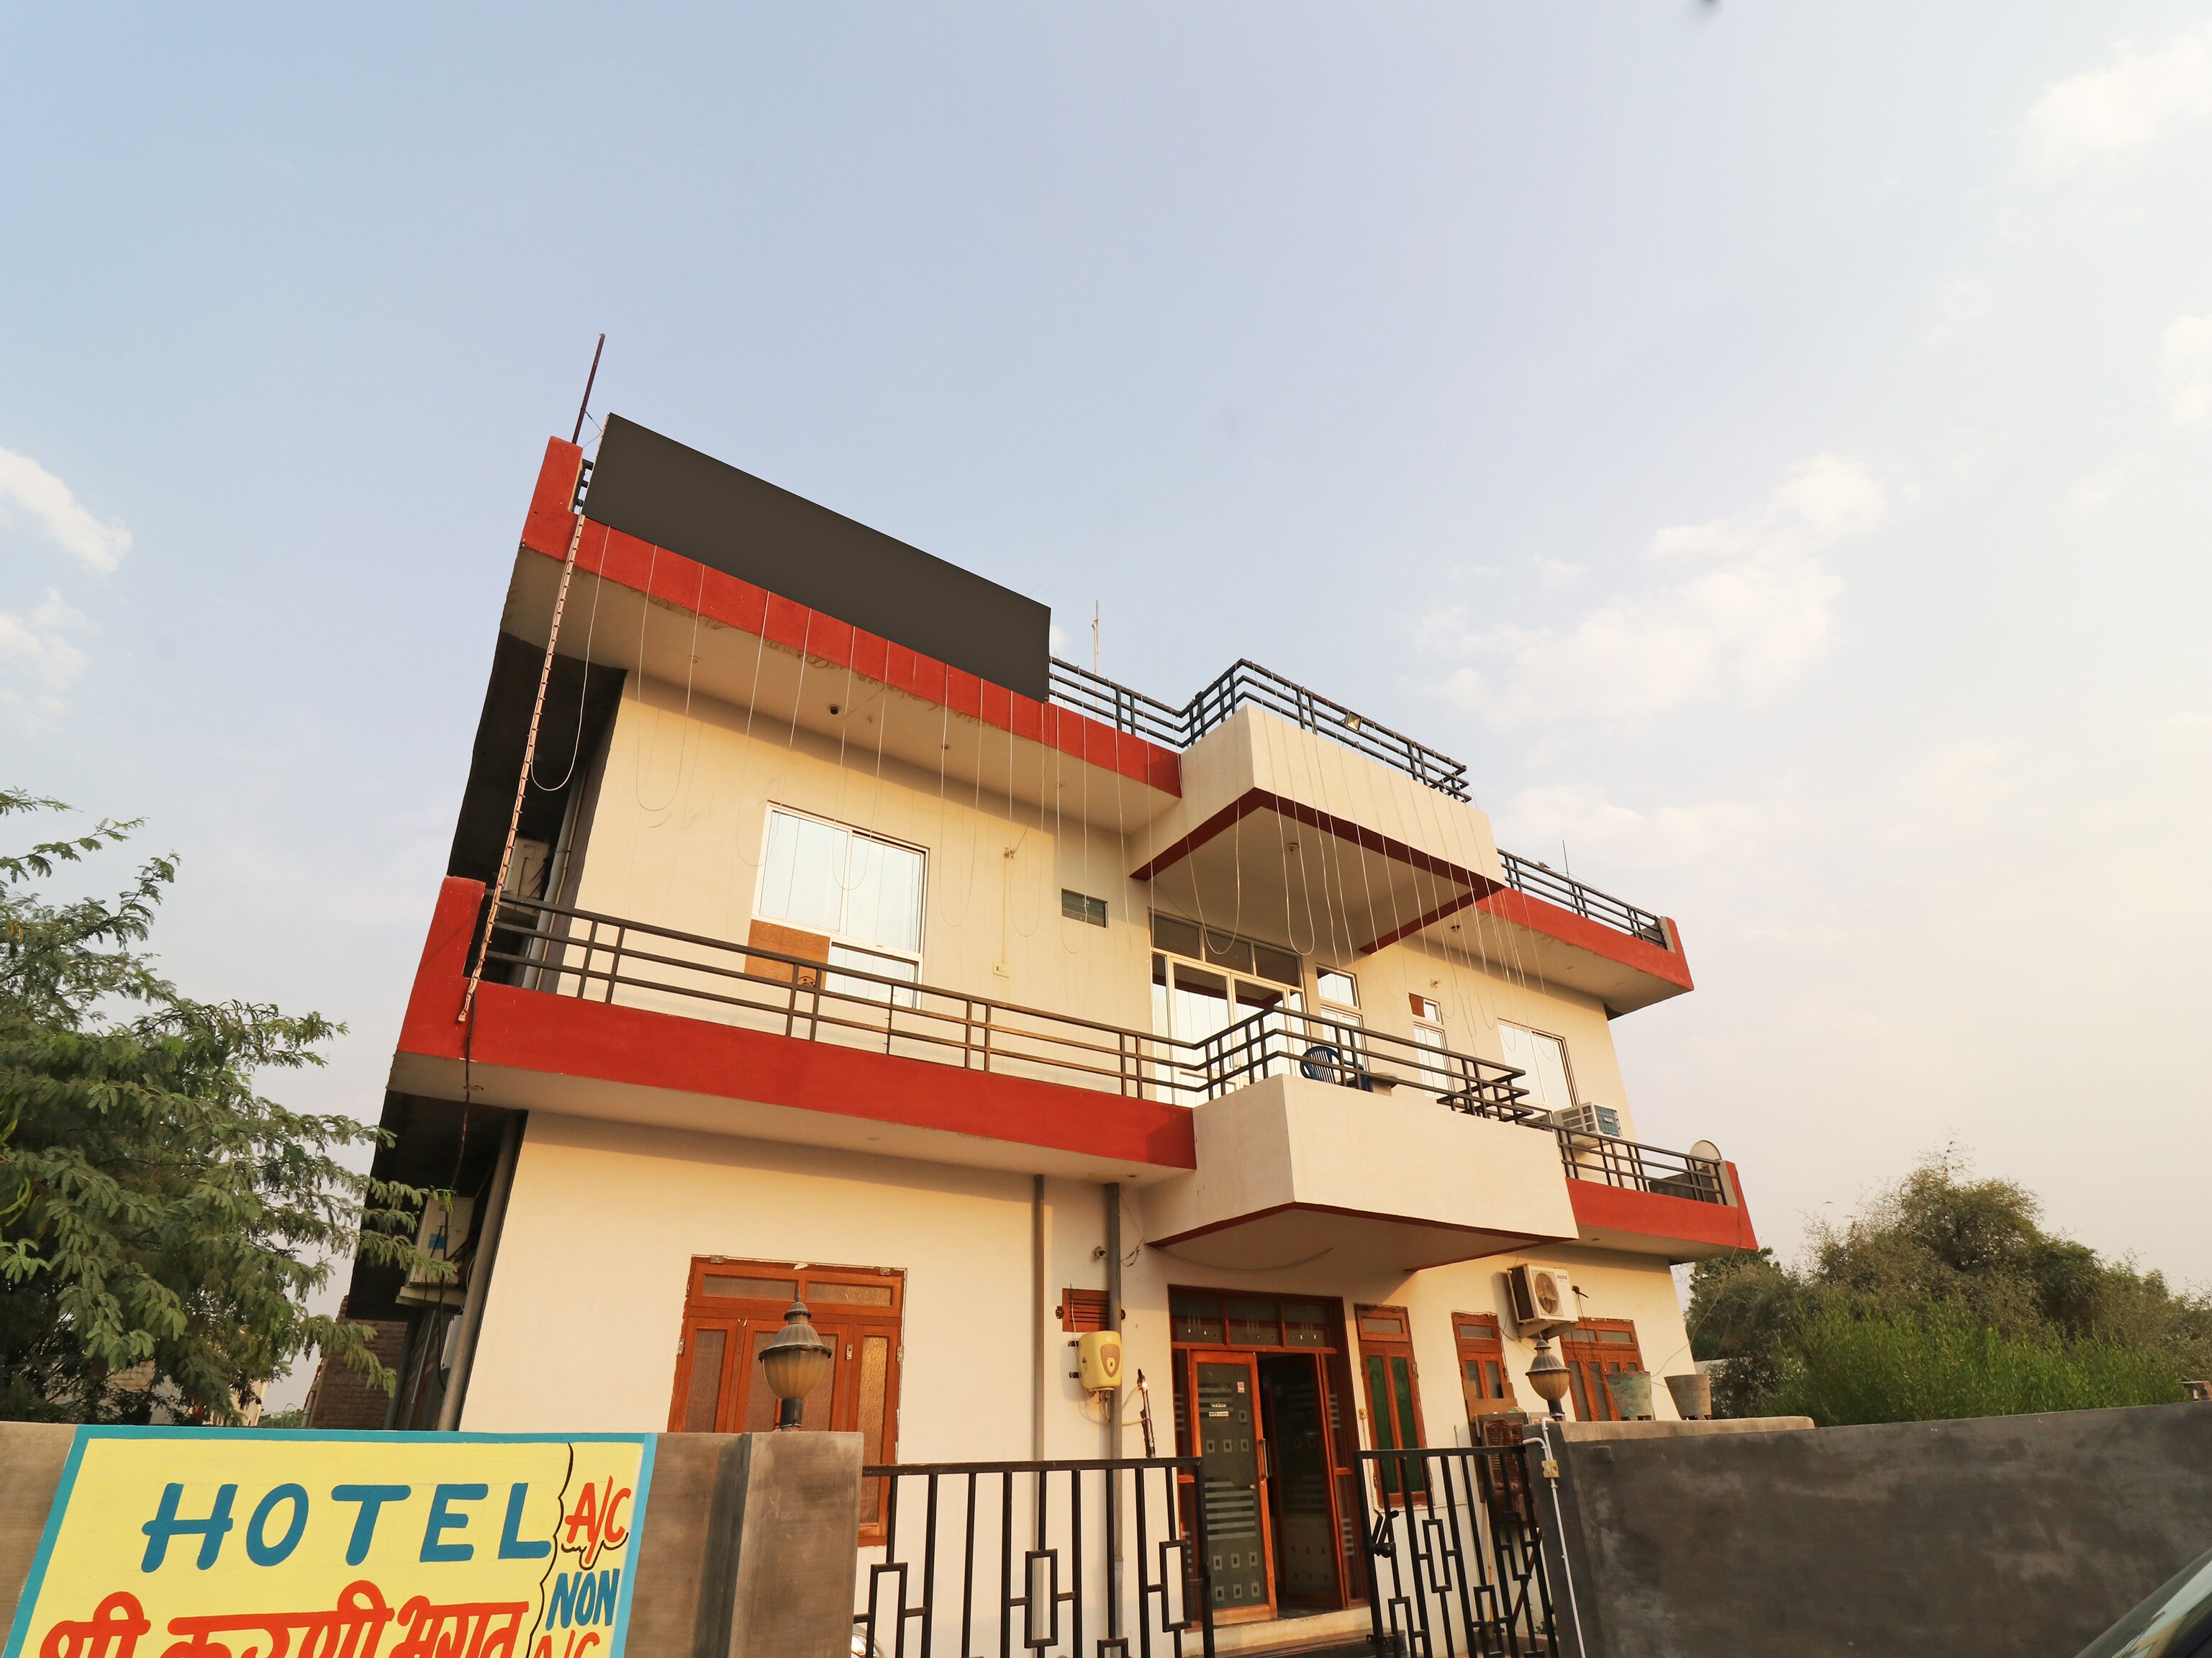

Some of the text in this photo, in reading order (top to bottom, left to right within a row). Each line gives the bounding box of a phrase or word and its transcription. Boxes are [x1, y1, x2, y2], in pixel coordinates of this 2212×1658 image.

[141, 1482, 552, 1573] HOTEL
[564, 1475, 632, 1564] A/C
[545, 1568, 621, 1631] NON
